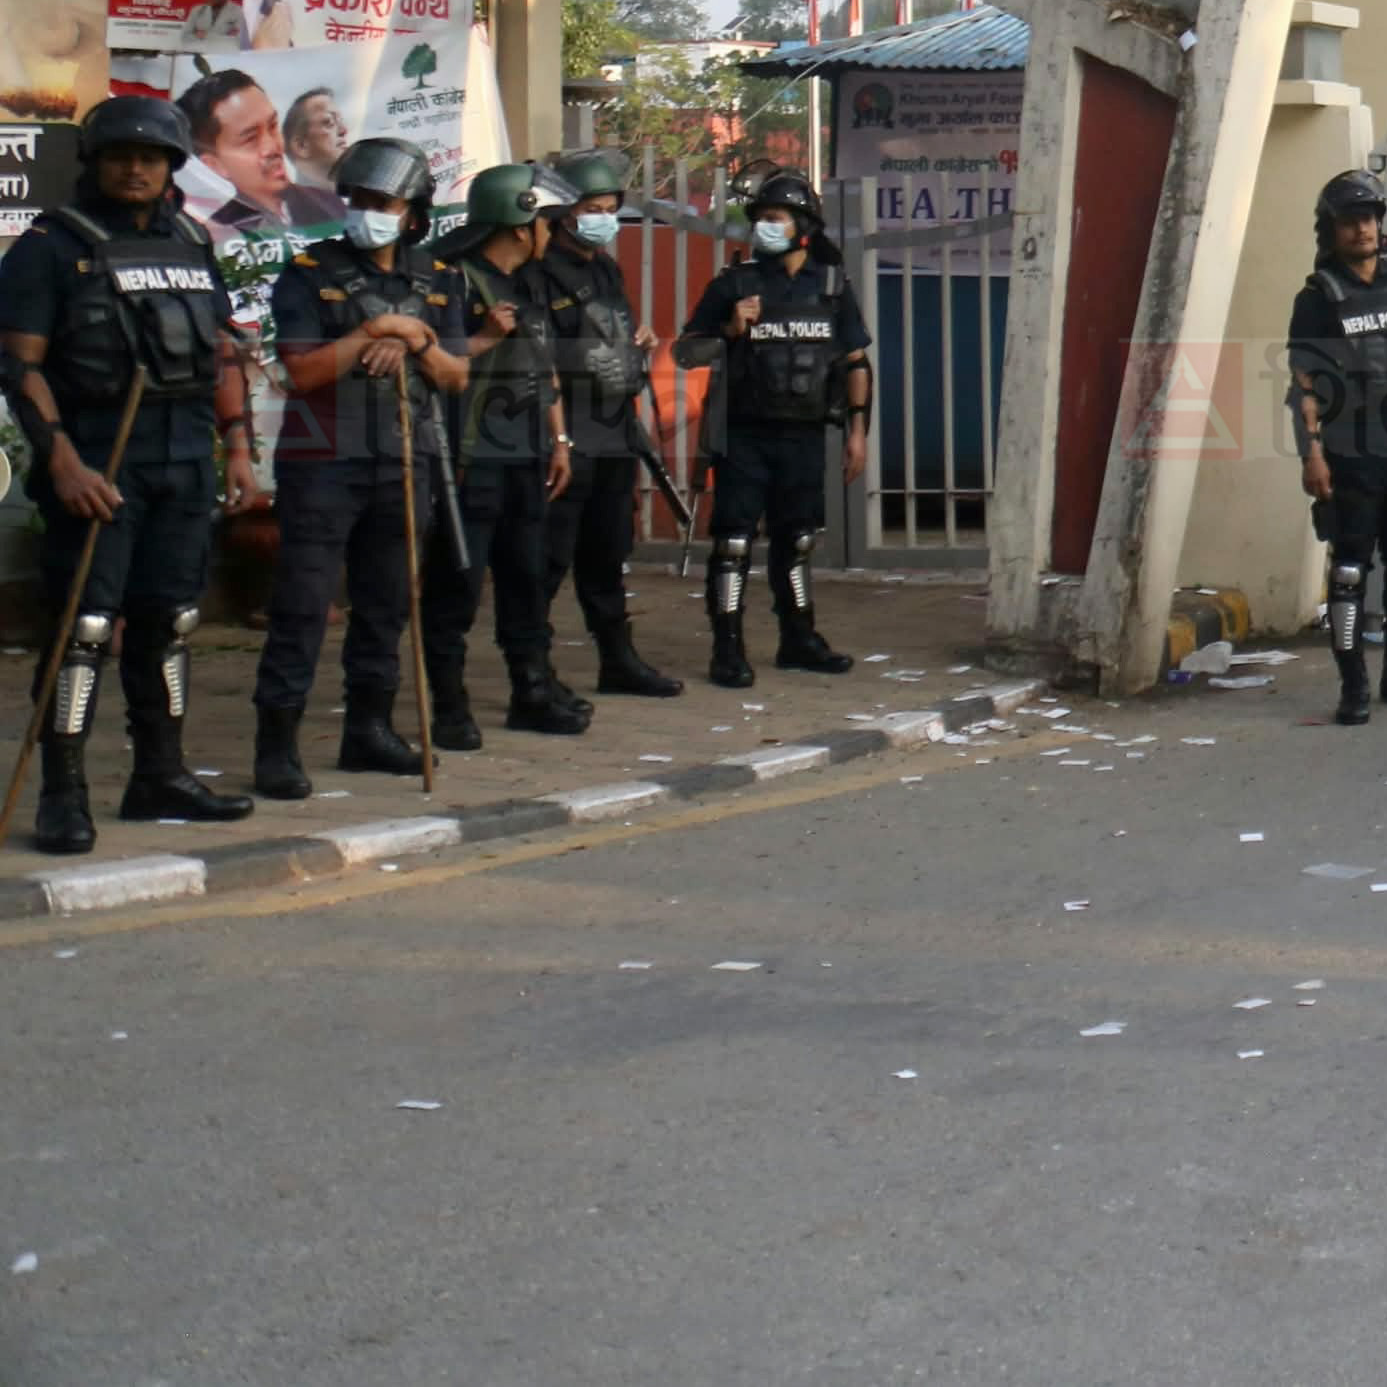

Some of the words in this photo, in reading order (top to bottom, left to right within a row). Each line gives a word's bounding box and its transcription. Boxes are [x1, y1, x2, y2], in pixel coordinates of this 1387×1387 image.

[386, 93, 429, 115] नेपाली
[115, 268, 169, 292] NEPAL
[750, 322, 787, 340] NEPAL
[788, 321, 831, 338] POLICE
[1342, 314, 1380, 335] NEPAL
